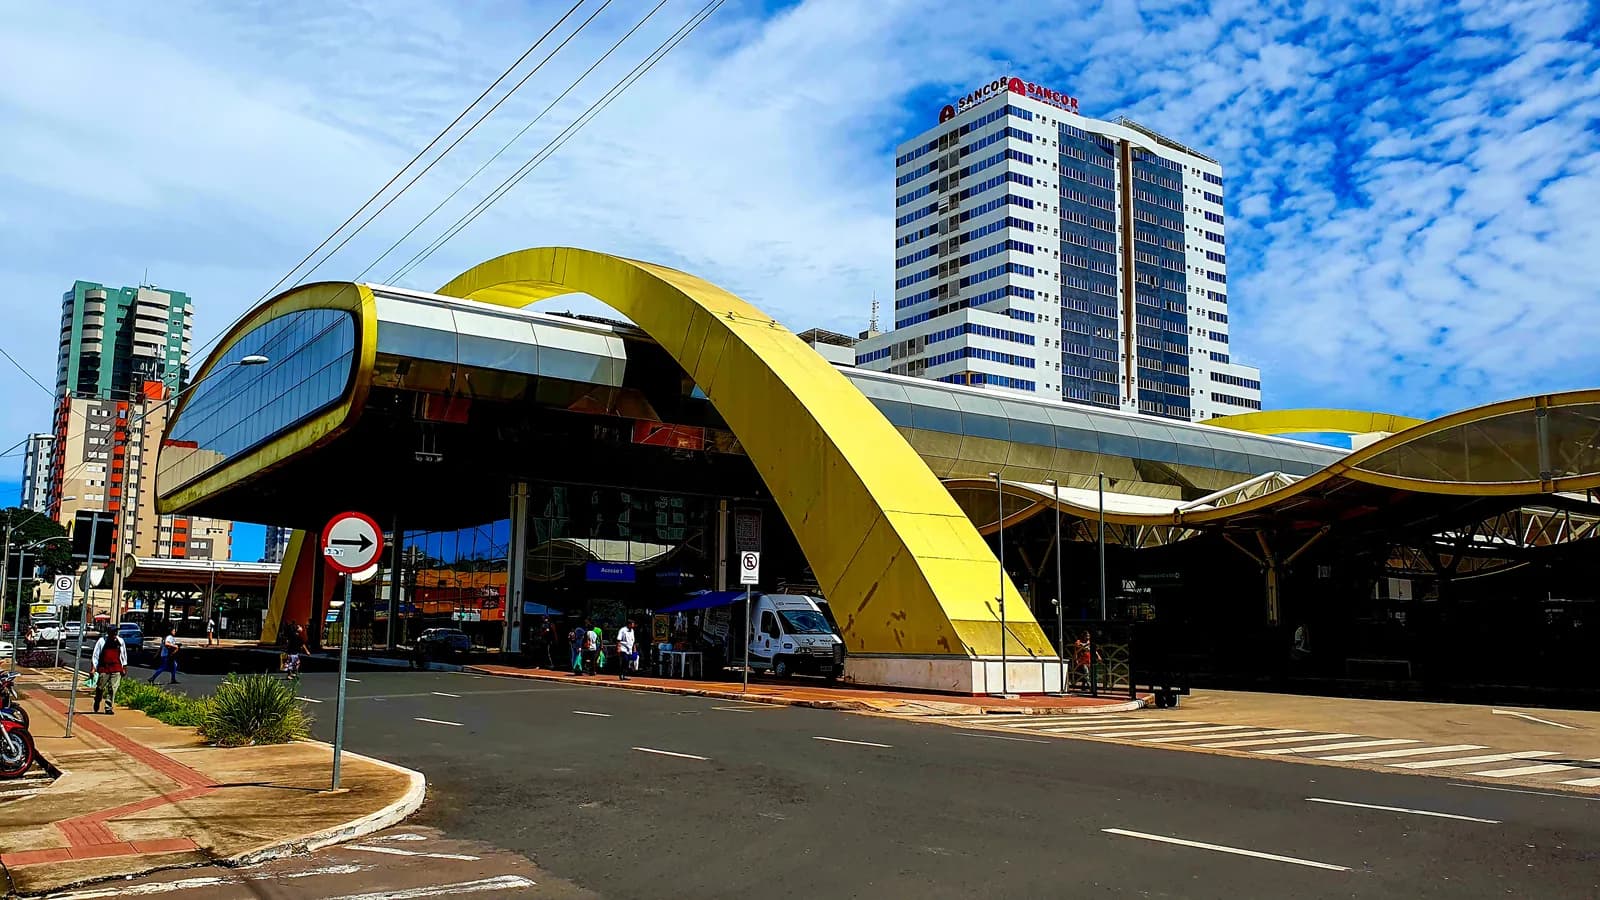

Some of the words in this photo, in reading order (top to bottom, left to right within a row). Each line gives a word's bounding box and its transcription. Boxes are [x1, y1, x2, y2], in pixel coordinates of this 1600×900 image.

[958, 76, 1007, 108] SANCOR
[1027, 82, 1079, 108] SANCOR
[61, 580, 68, 588] E
